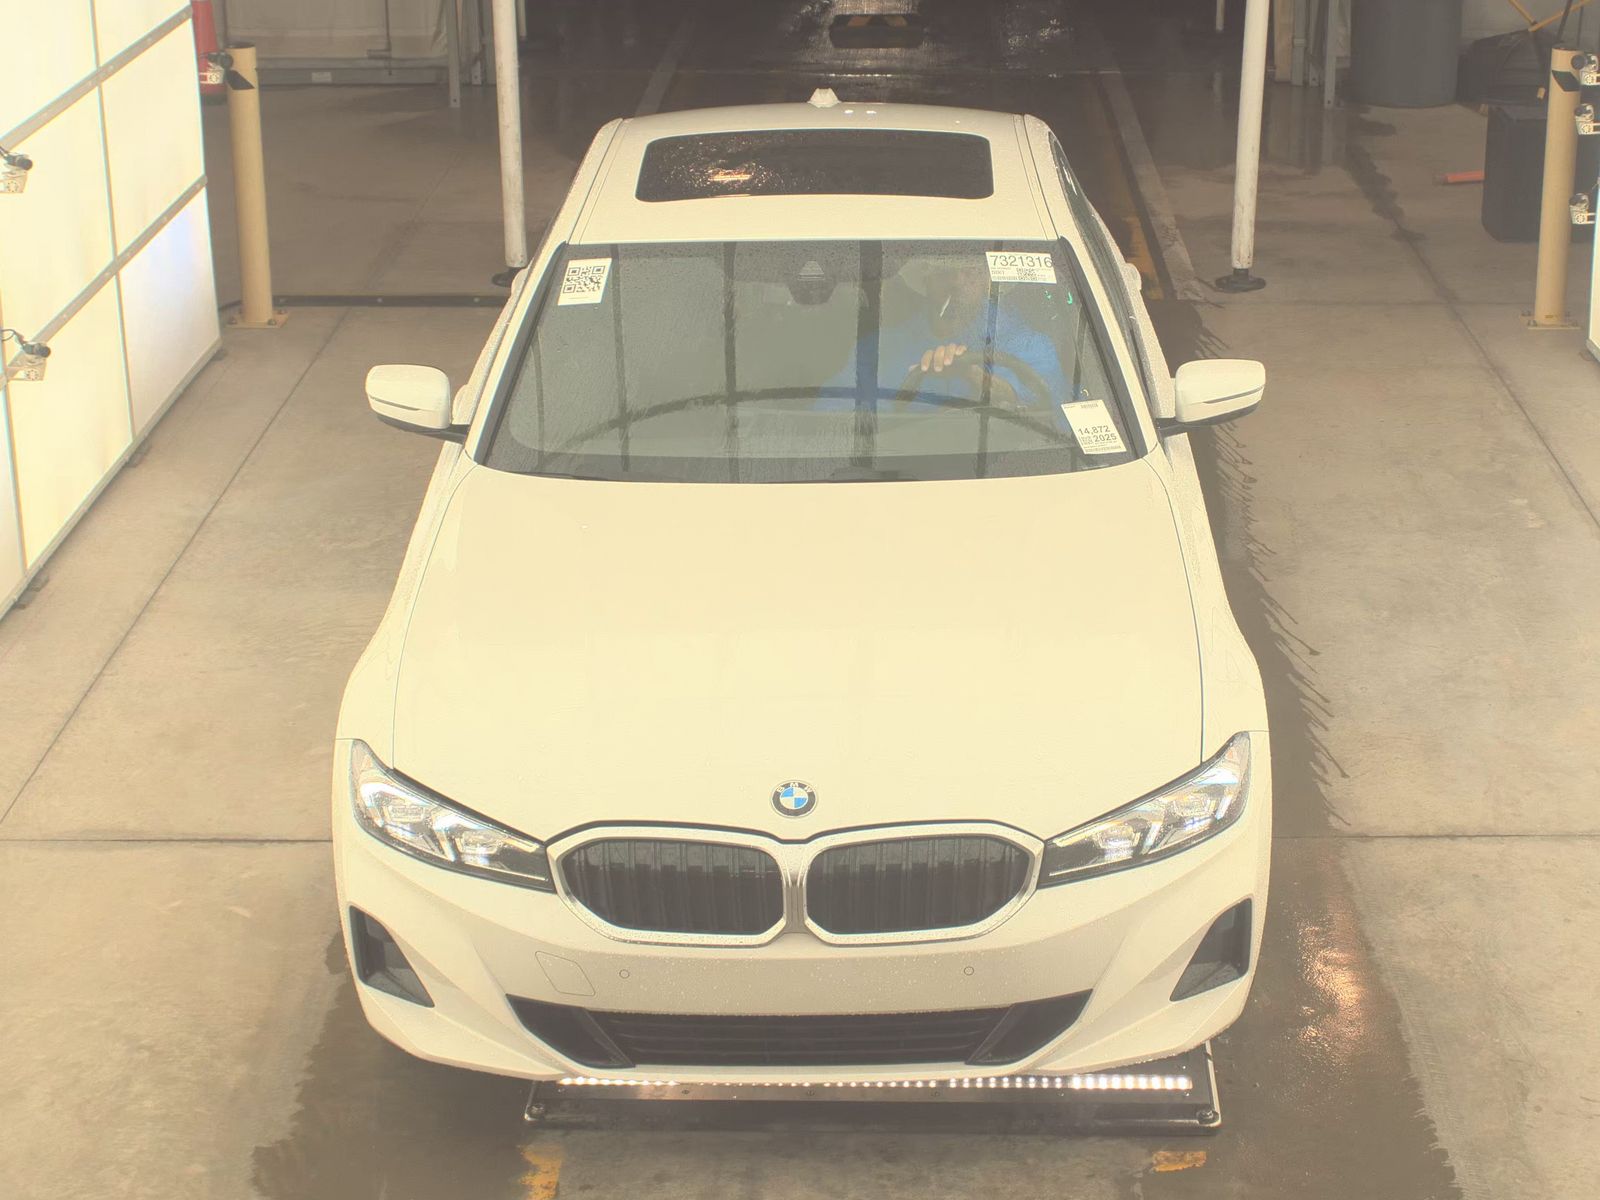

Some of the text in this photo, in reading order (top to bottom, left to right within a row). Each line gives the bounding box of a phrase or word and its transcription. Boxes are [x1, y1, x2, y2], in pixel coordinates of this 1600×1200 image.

[989, 255, 1054, 269] 7321316
[1078, 425, 1111, 436] 14,872
[1093, 433, 1117, 443] 2025
[775, 781, 815, 793] BMW
